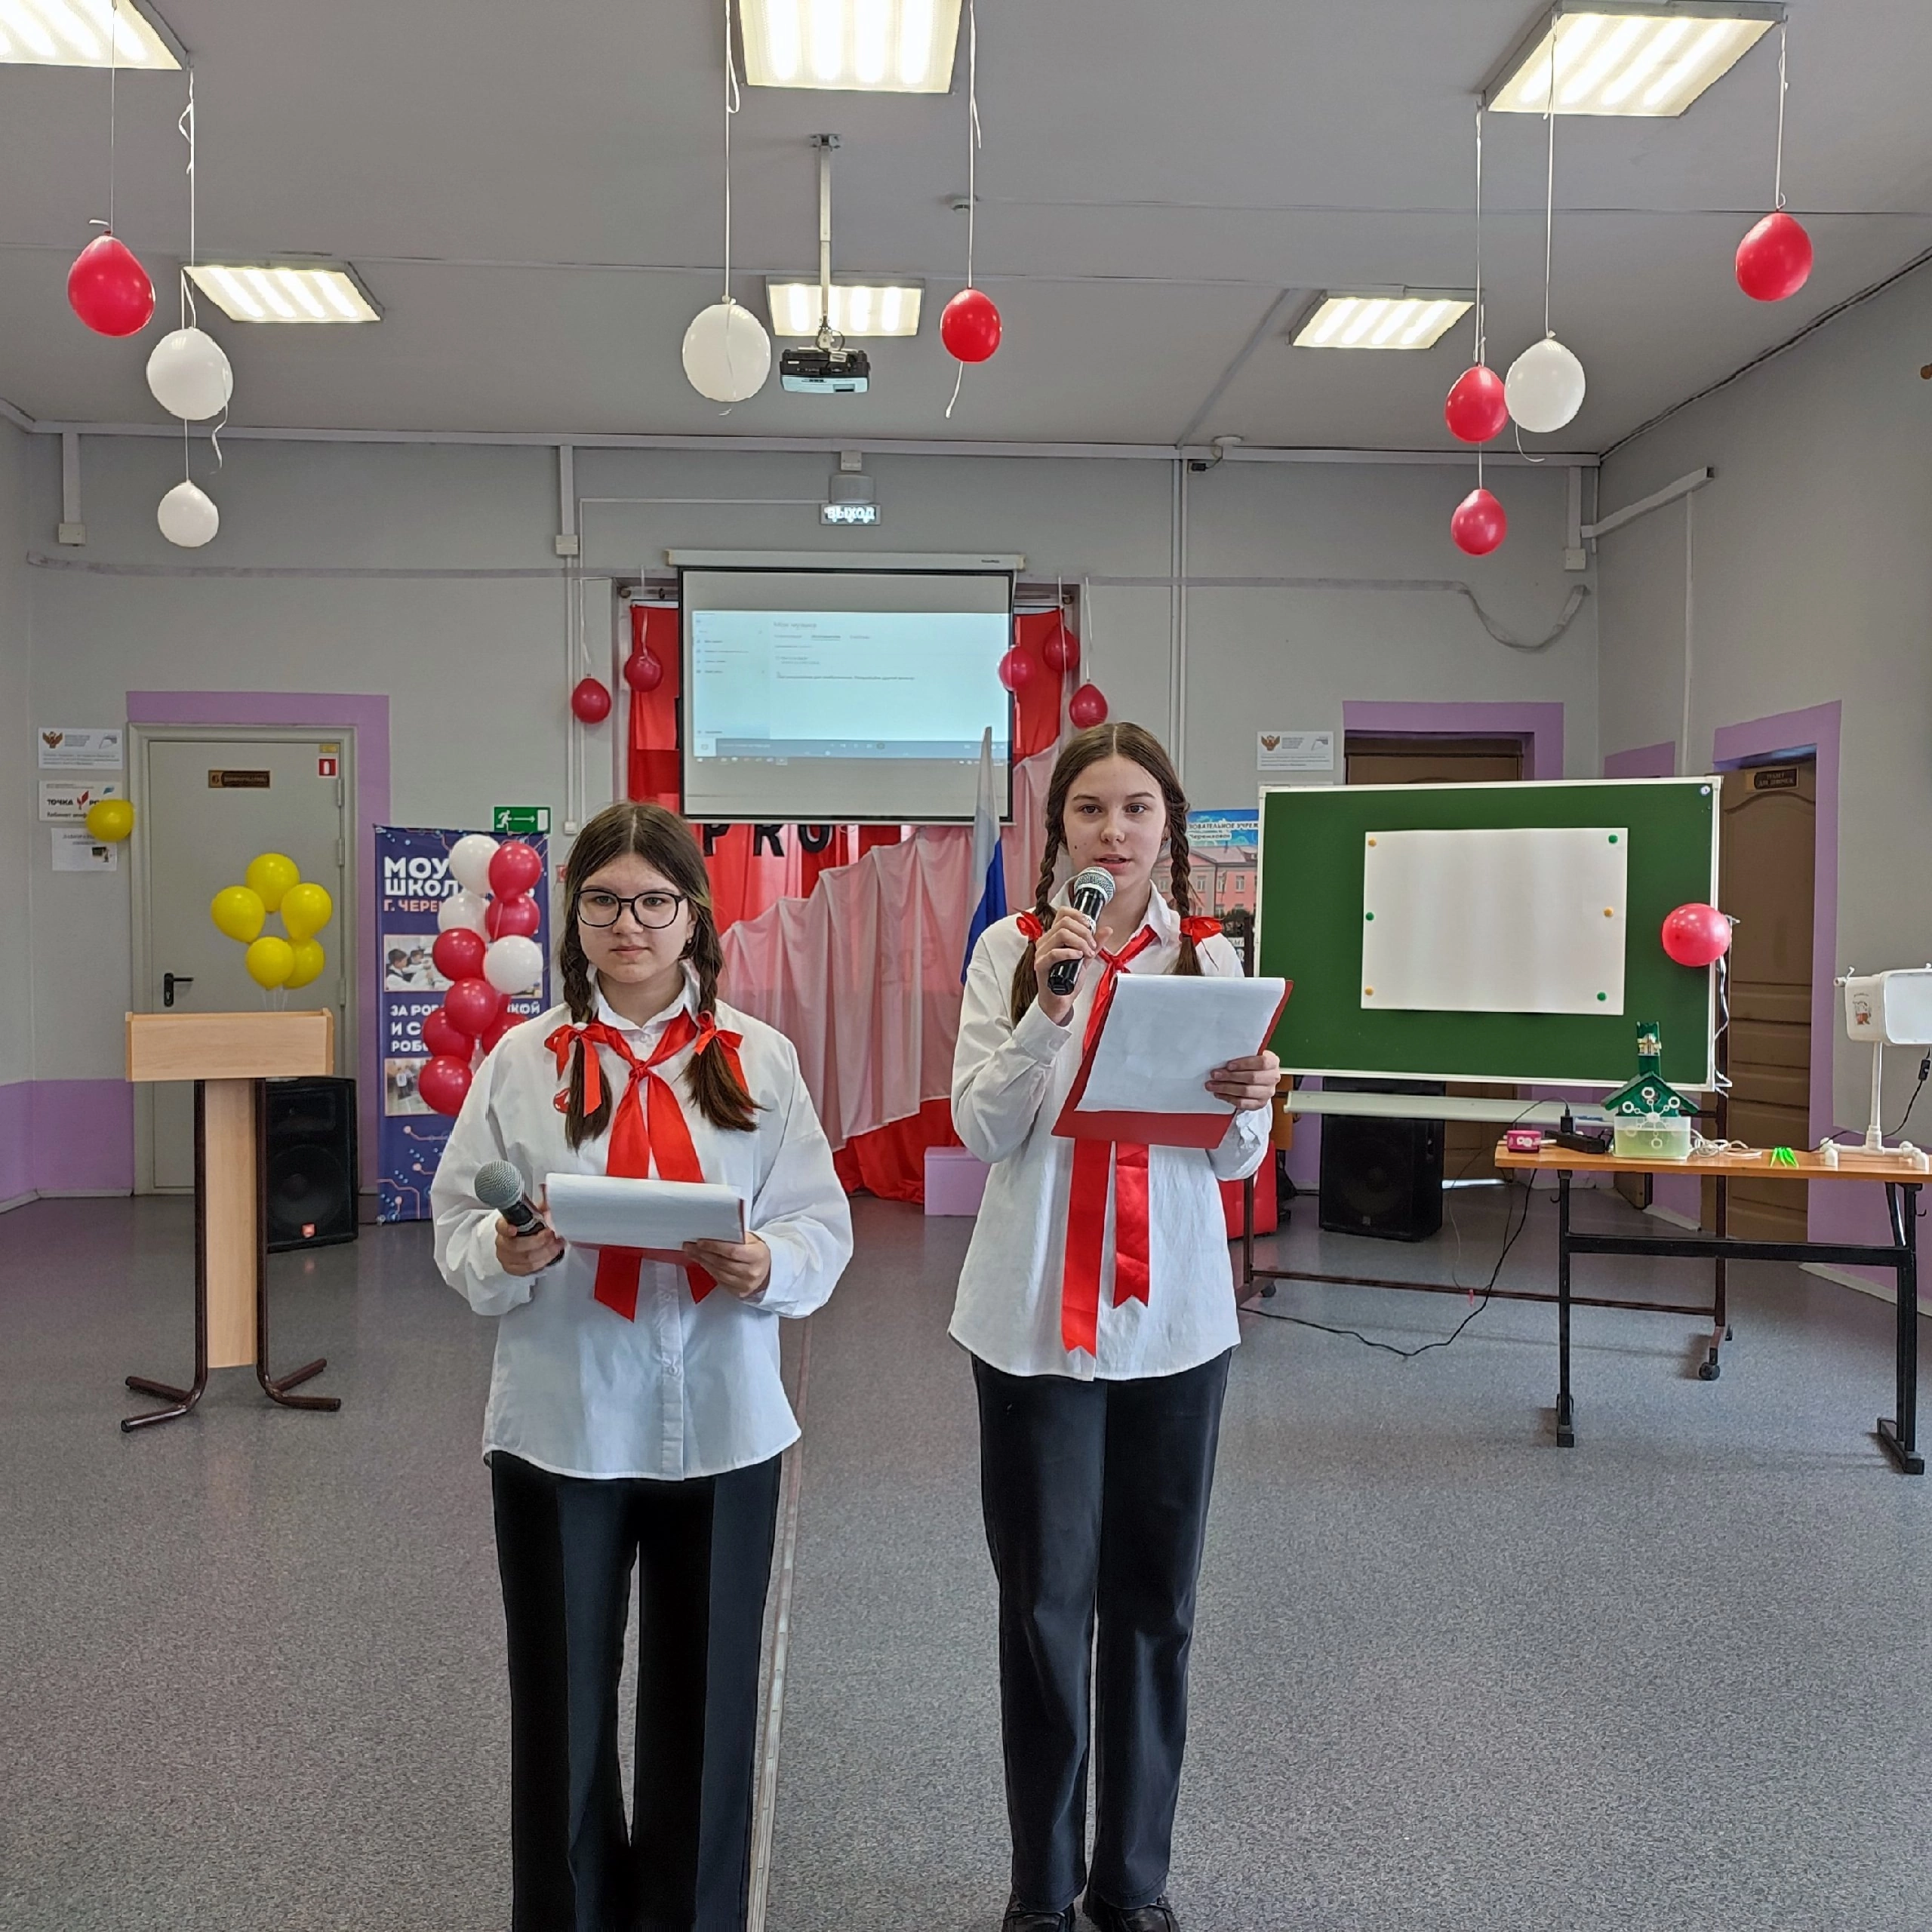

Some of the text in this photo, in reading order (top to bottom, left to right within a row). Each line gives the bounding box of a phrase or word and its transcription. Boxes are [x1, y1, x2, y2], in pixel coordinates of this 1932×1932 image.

[824, 506, 875, 521] ВЫХОД
[384, 857, 450, 878] МОУ
[385, 878, 459, 897] ШКОЛ
[398, 899, 441, 912] ЧЕРЕ
[390, 1004, 408, 1016] ЗА
[391, 1021, 402, 1035] И
